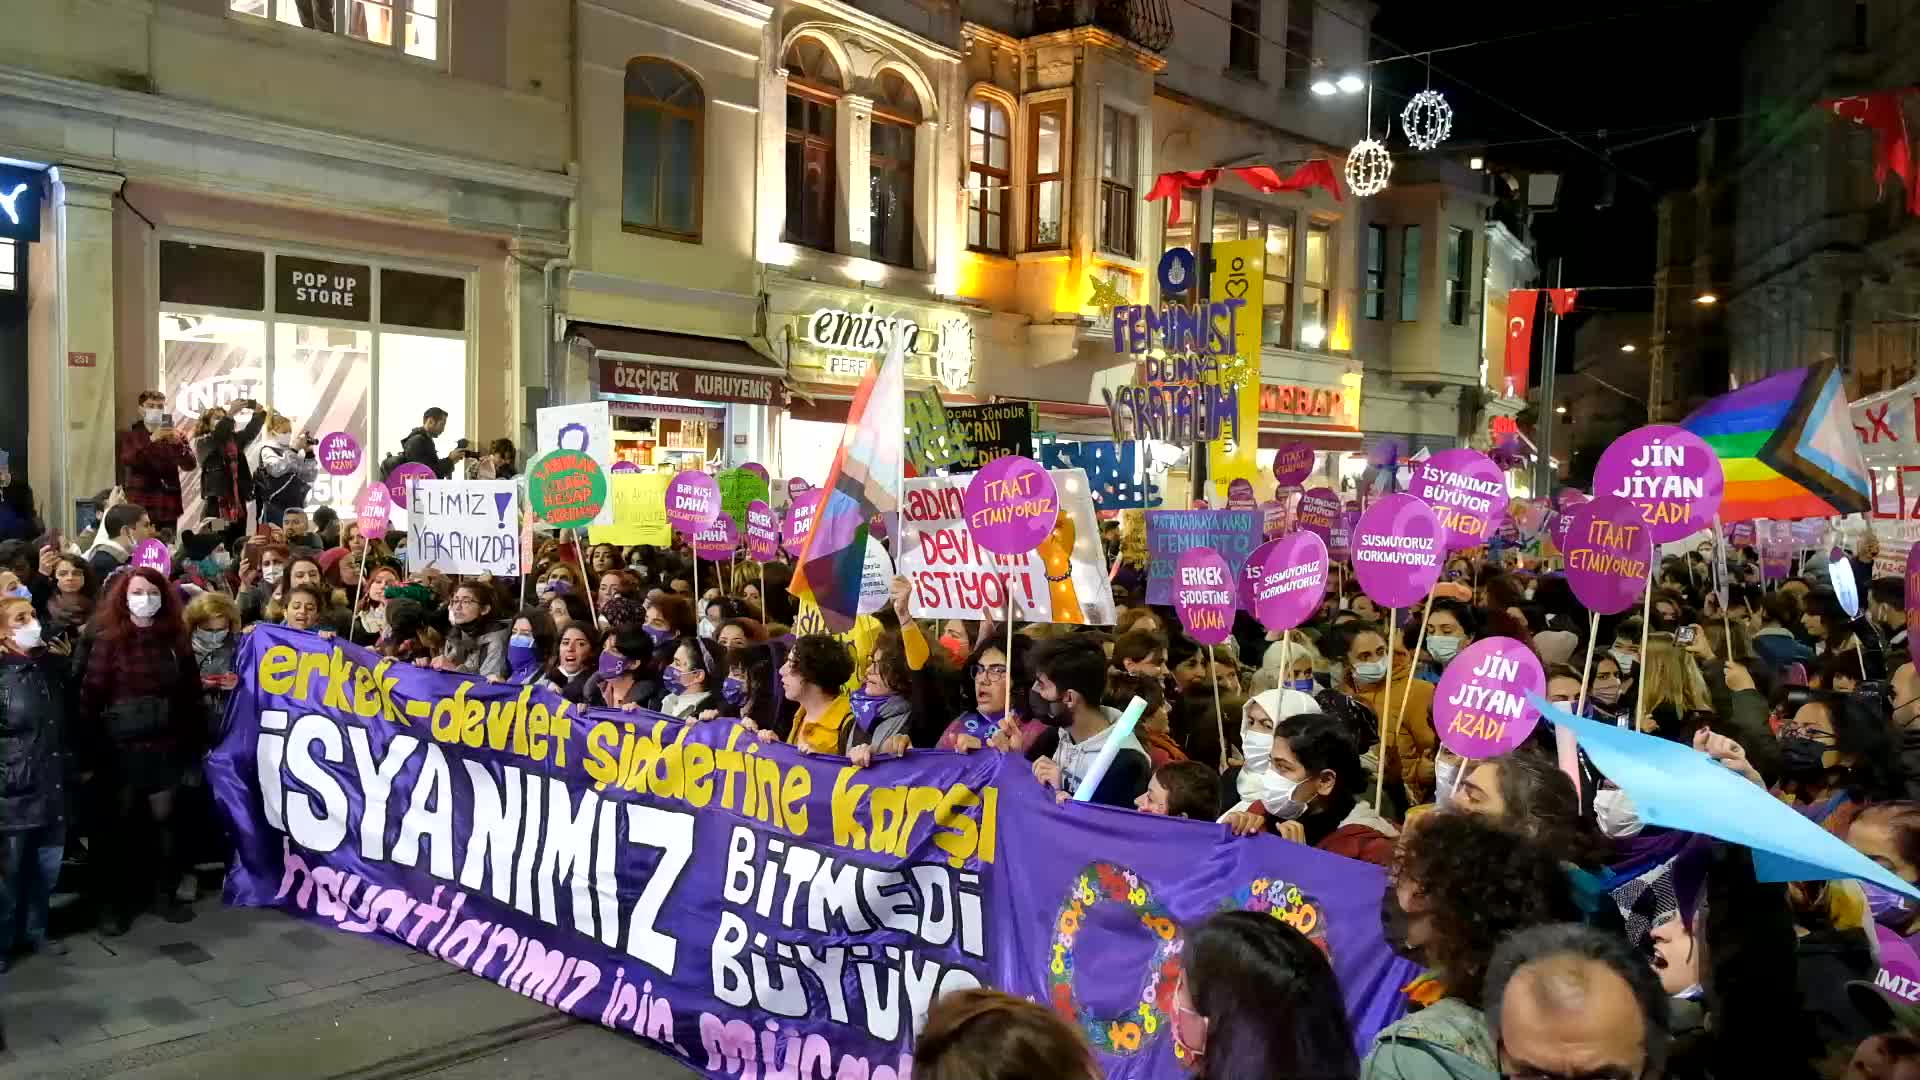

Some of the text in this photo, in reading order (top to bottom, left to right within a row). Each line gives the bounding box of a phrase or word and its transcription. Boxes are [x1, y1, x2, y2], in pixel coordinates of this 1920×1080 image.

[293, 271, 357, 291] POP UP
[297, 288, 353, 306] STORE
[831, 357, 868, 373] PERF
[614, 362, 772, 404] ÖZÇİÇEK KURUYEMİŞ
[981, 404, 1025, 420] SÖNDÜR
[325, 449, 355, 461] JİYAN
[330, 437, 347, 448] JİN
[1631, 438, 1685, 467] JİN
[984, 472, 1037, 504] İTAAT
[1422, 462, 1504, 497] İSYANIMIZ
[1612, 470, 1704, 499] JİYAN
[369, 488, 382, 502] JİN
[413, 480, 487, 515] ELİMİZ
[675, 495, 710, 513] DAHA
[1423, 483, 1492, 513] BÜYÜYOR
[362, 502, 385, 517] JİYAN
[749, 511, 772, 528] ERKEK
[972, 499, 1054, 529] ETMİYORUZ
[1636, 499, 1691, 525] ZADİ
[794, 519, 814, 535] DA
[1587, 515, 1640, 549] İTAAT
[142, 545, 159, 560] JİN
[413, 523, 514, 563] YAKANIZDA
[1361, 534, 1434, 550] SUSMUYORUZ
[1357, 551, 1437, 567] KORKMUYORUZ
[1570, 548, 1648, 580] ETMİYORUZ
[1181, 566, 1223, 586] ERKEK
[1264, 561, 1320, 585] SUSMUYORUZ
[1180, 589, 1230, 608] ŞİDDETİNE
[1260, 574, 1322, 601] KORKMUYORUZ
[1188, 607, 1225, 630] SUSMA
[1473, 650, 1520, 683] JİN
[259, 644, 572, 768] erkek-devlet
[1448, 679, 1526, 719] JİYAN
[1447, 710, 1507, 743] AZADİ
[257, 709, 695, 977] İSYANIMIZ
[723, 826, 985, 957] BİTMEDİ
[276, 835, 602, 1013] hayatlarımız
[1874, 967, 1920, 1001] IMIZ
